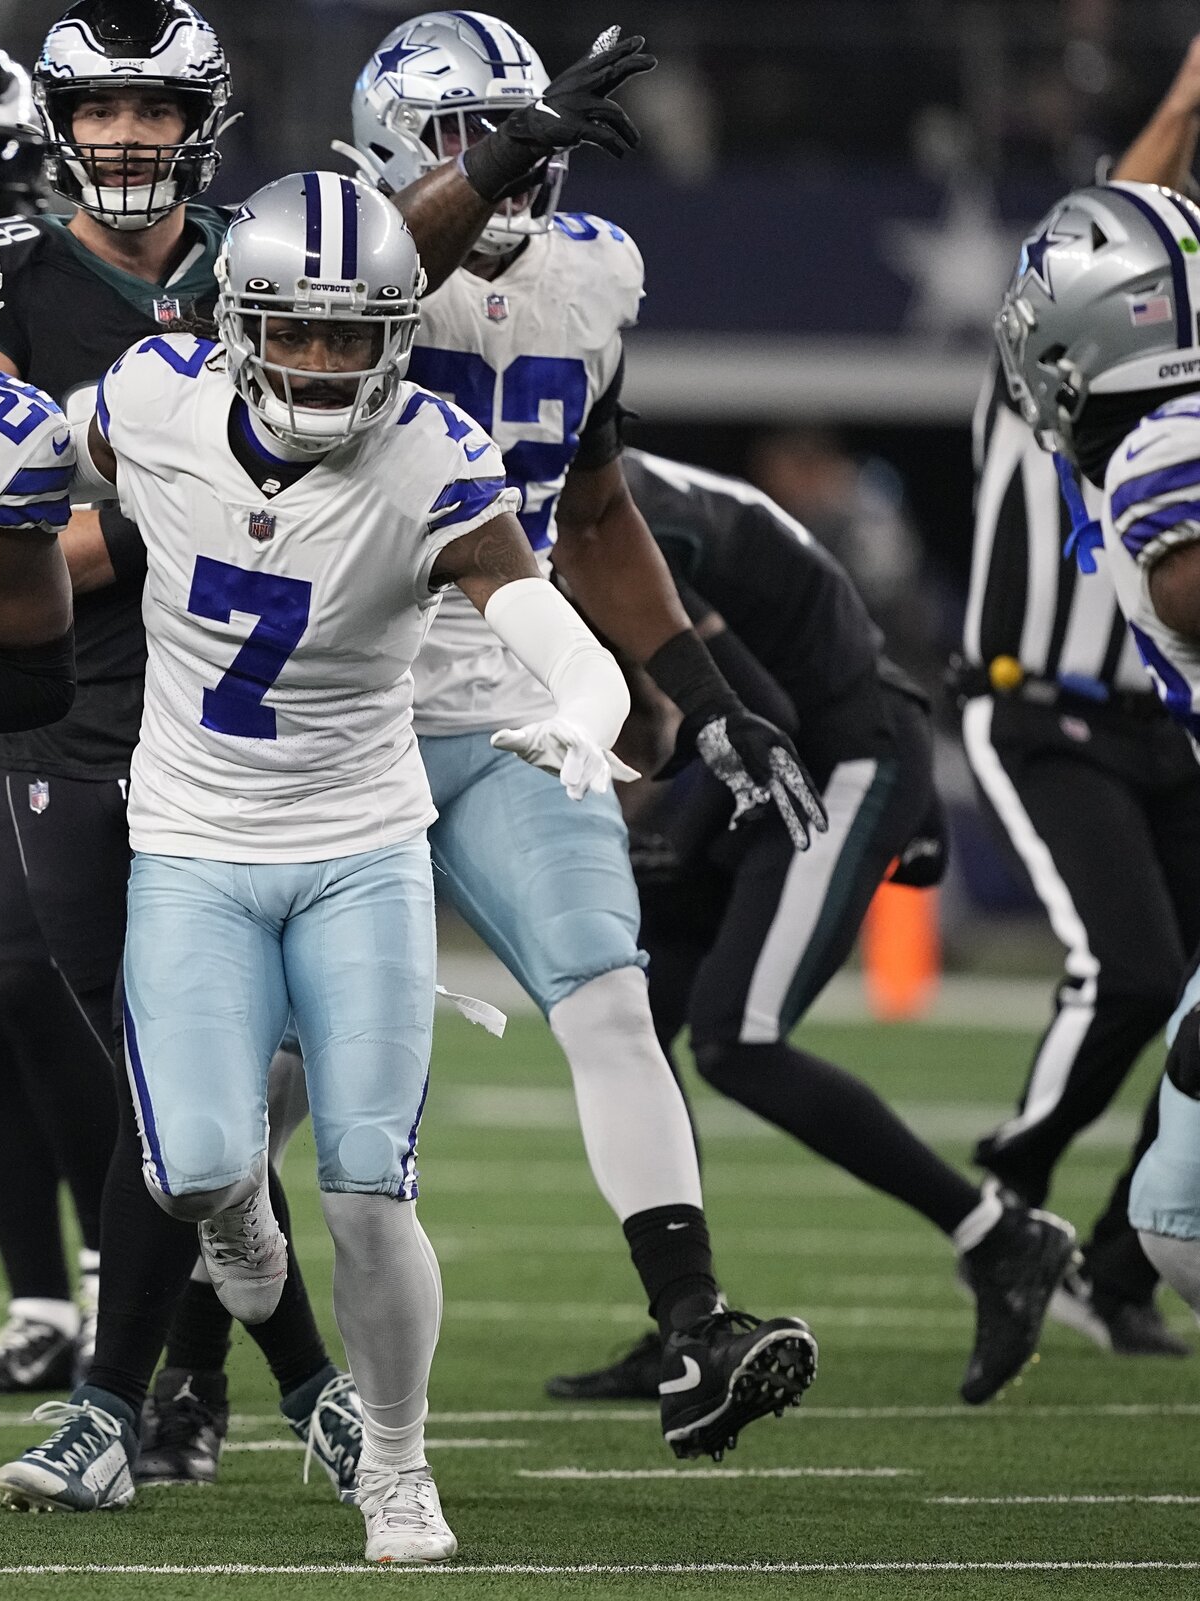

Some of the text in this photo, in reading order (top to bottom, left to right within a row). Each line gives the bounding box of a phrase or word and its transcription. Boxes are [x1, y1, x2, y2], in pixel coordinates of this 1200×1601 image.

[311, 283, 350, 292] COWBOYS
[136, 336, 218, 378] 7
[187, 555, 313, 740] 7
